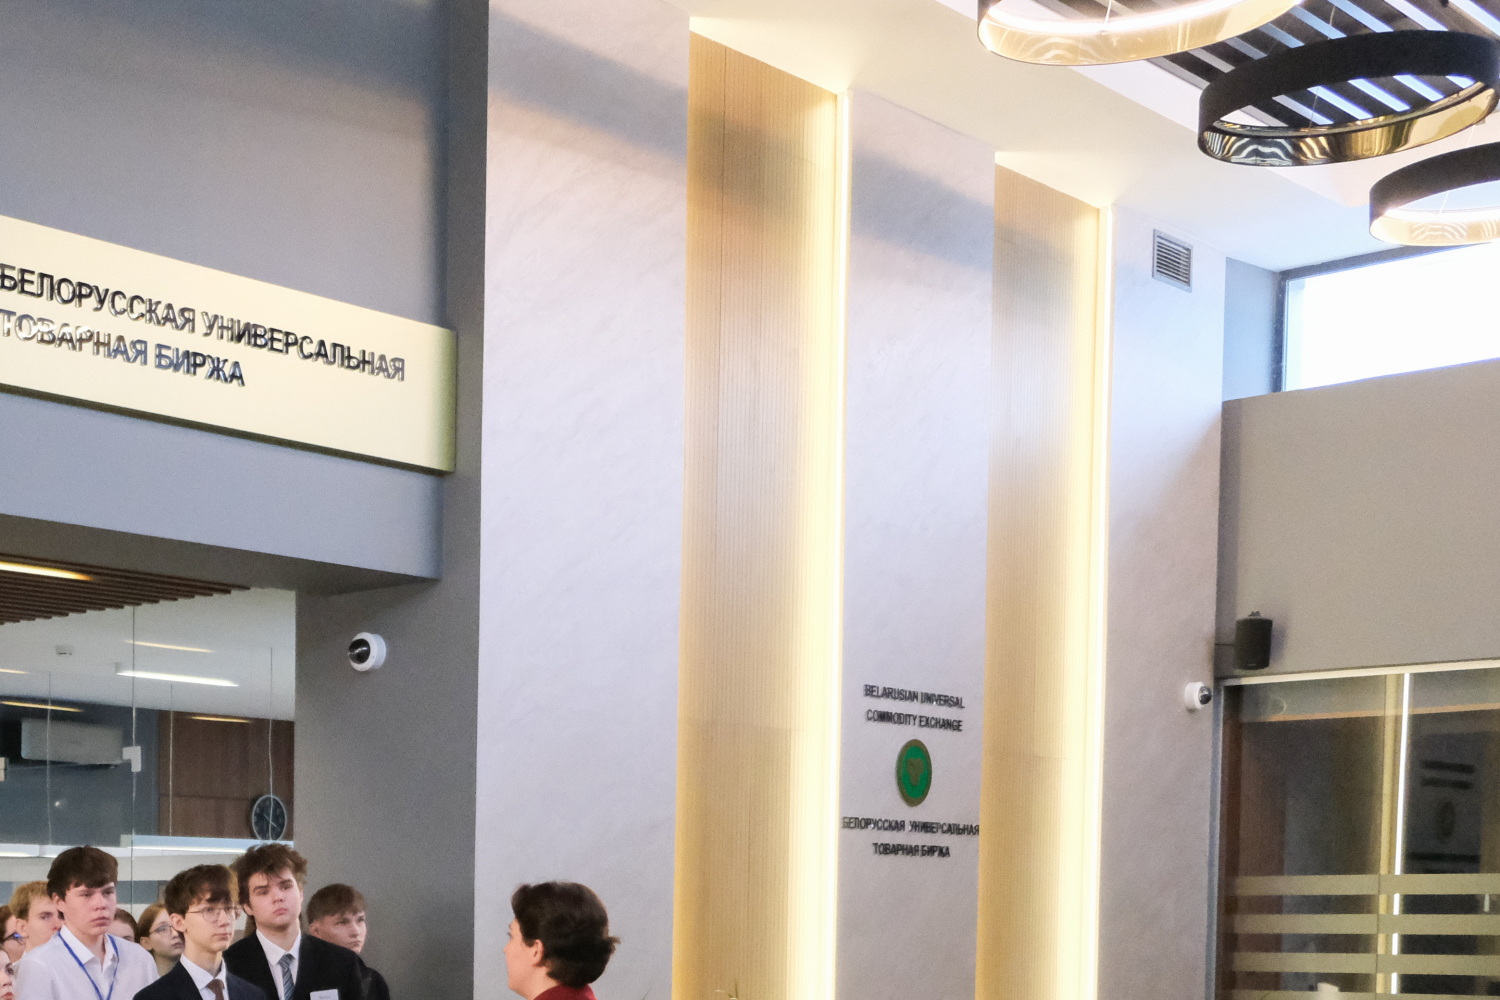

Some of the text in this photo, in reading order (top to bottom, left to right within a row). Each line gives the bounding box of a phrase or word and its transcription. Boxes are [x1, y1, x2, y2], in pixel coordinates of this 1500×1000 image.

[201, 311, 406, 382] УНИВЕРСАЛЬНАЯ
[155, 343, 246, 387] БИРЖА
[864, 684, 965, 708] BELARUSIAN UNIVERSAL
[866, 709, 963, 732] COMMODITY EXCHANGE
[842, 816, 980, 835] БЕЛОРУССКАЯ УНИВЕРСАЛЬНАЯ
[872, 842, 950, 857] ТОВАРНАЯ БИРЖА
